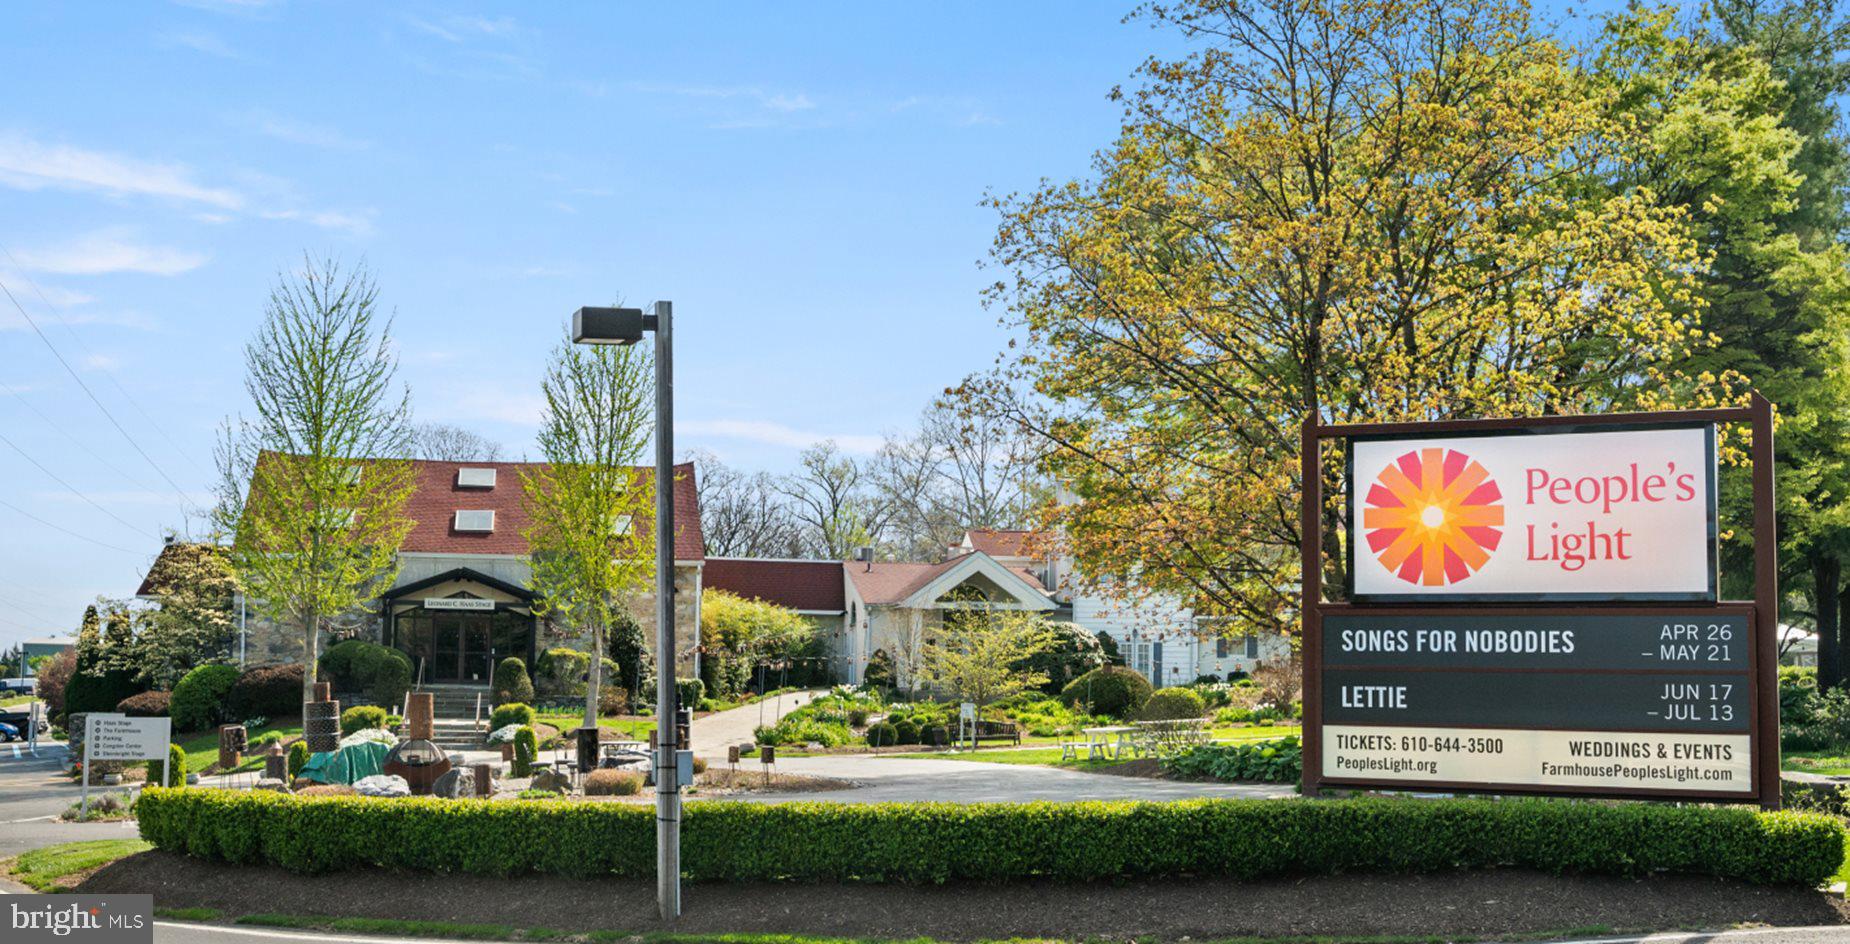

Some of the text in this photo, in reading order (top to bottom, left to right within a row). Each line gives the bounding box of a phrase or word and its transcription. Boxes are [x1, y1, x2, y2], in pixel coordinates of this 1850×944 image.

[1526, 520, 1633, 572] Light
[1341, 629, 1575, 654] SONGS FOR NOBODIES
[1660, 624, 1733, 641] APR 26
[1660, 644, 1700, 661] MAY
[1707, 644, 1731, 661] 21
[1341, 685, 1408, 709] LETTIE
[1660, 683, 1733, 701] JUN 17
[1664, 703, 1701, 721] JUL
[1709, 704, 1734, 721] 13
[1336, 734, 1504, 754] TICKETS: 610-644-3500
[1568, 740, 1733, 761] WEDDINGS & EVENTS
[1336, 755, 1438, 775] PeoplesLight.org
[1541, 761, 1733, 783] FarmhousePeoplesLight.com
